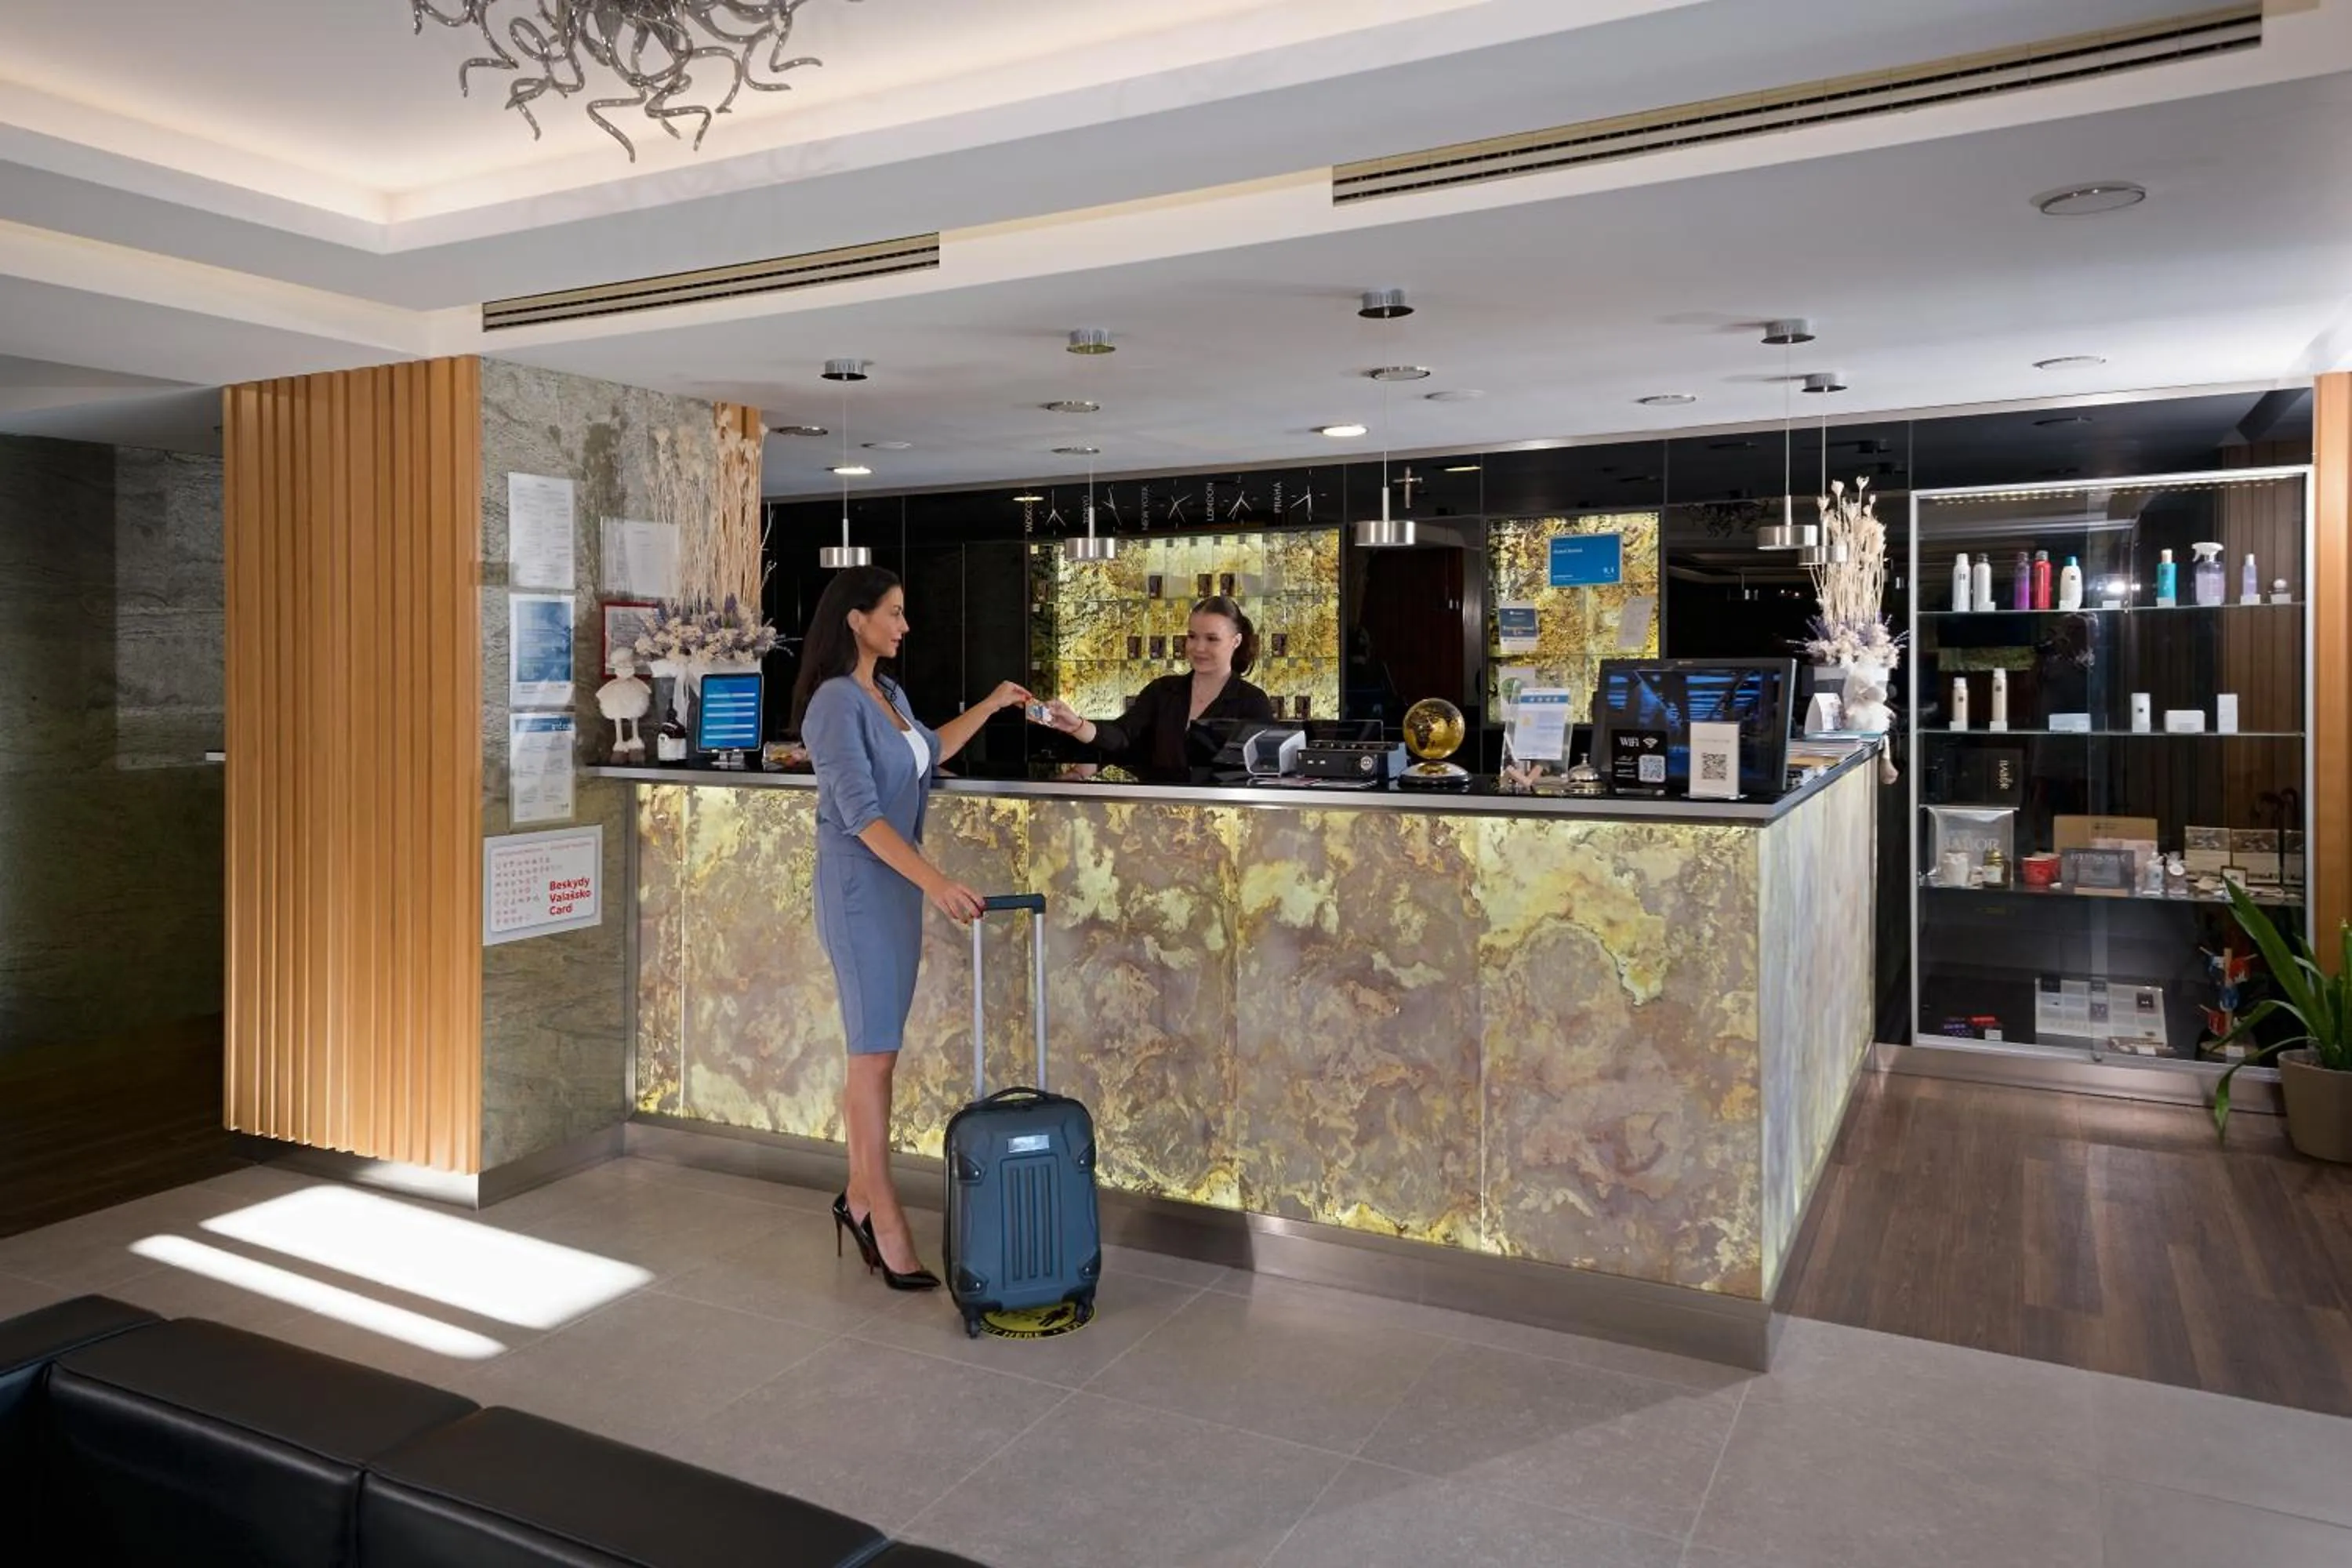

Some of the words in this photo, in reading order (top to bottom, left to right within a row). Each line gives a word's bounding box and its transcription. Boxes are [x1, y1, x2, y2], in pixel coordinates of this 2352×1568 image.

[550, 876, 590, 891] Beskydy
[550, 890, 591, 903] Valašsko
[550, 903, 572, 916] Card
